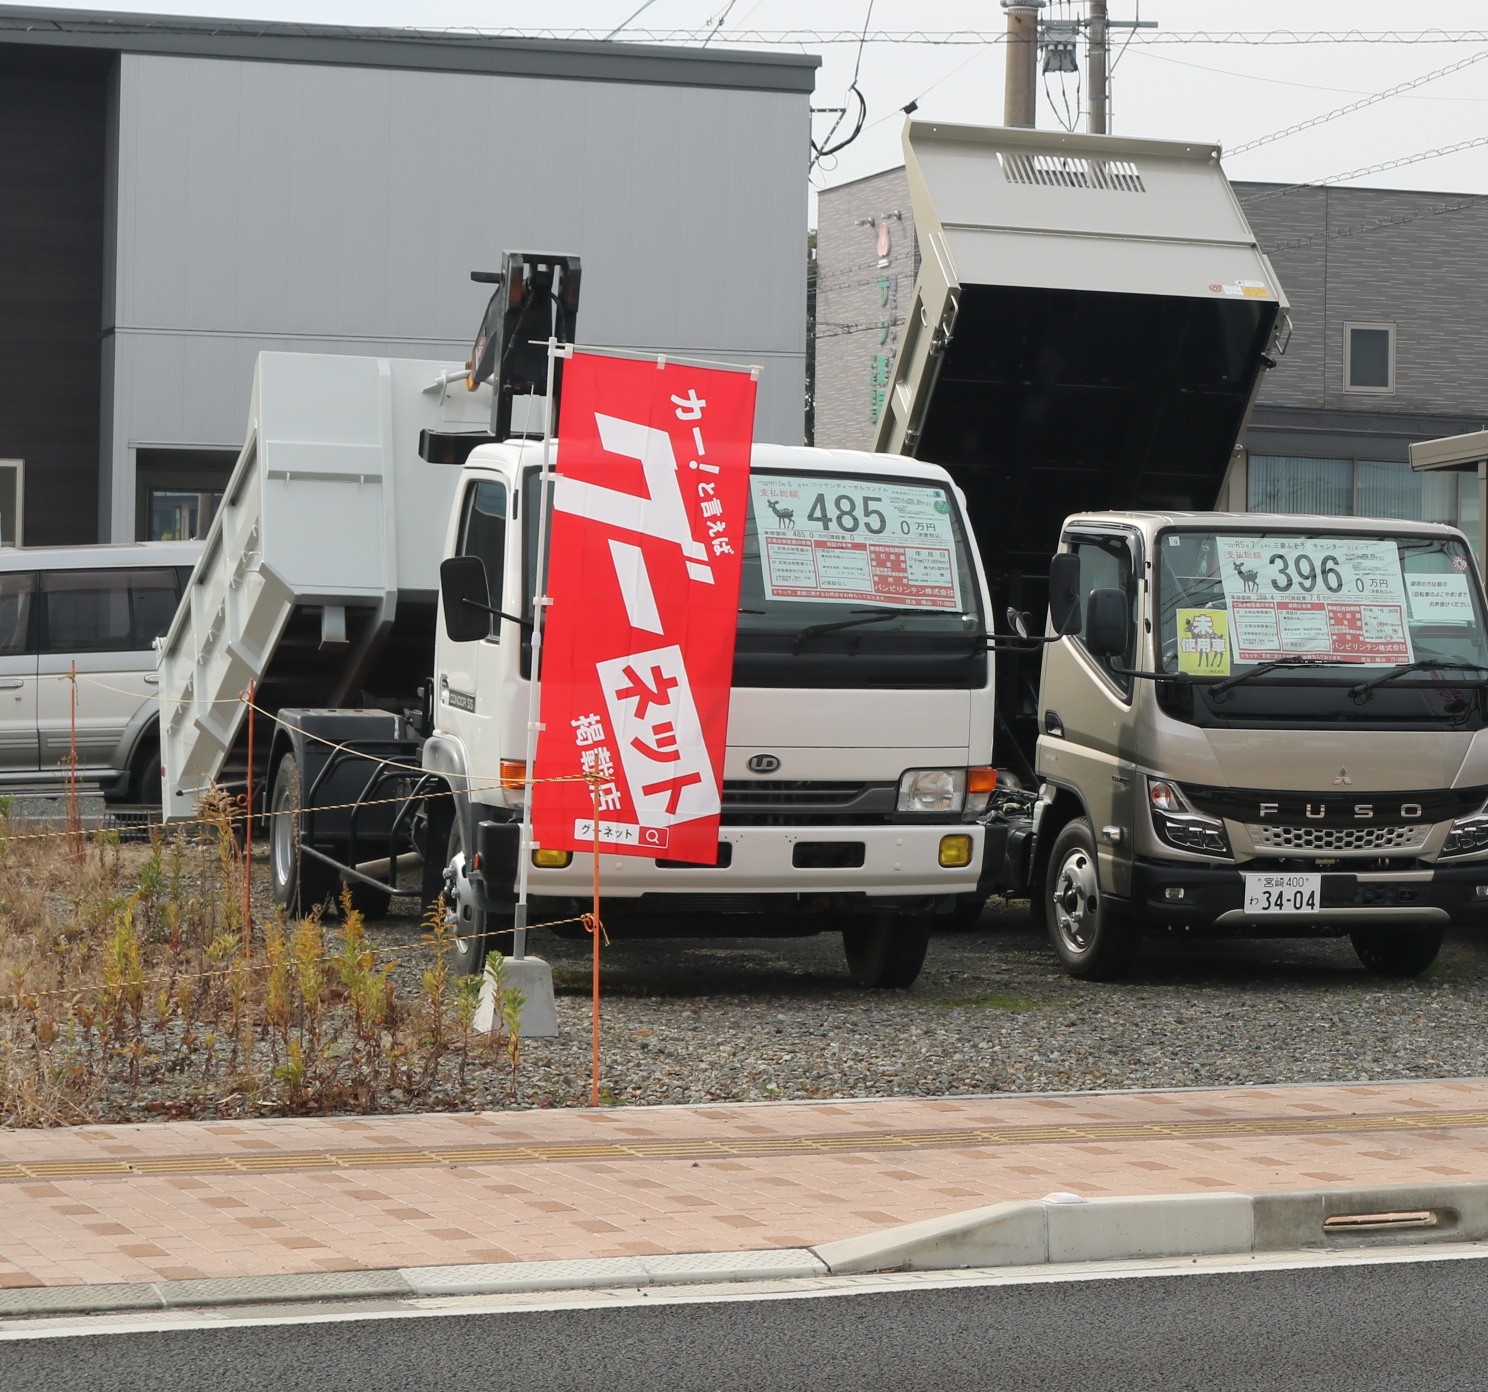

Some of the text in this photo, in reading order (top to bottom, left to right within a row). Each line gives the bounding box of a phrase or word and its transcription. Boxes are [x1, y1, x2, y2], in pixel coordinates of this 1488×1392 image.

[1182, 637, 1226, 653] 使用車
[751, 757, 779, 770] UD
[1259, 803, 1423, 819] FUSO
[1261, 890, 1316, 911] 34-04
